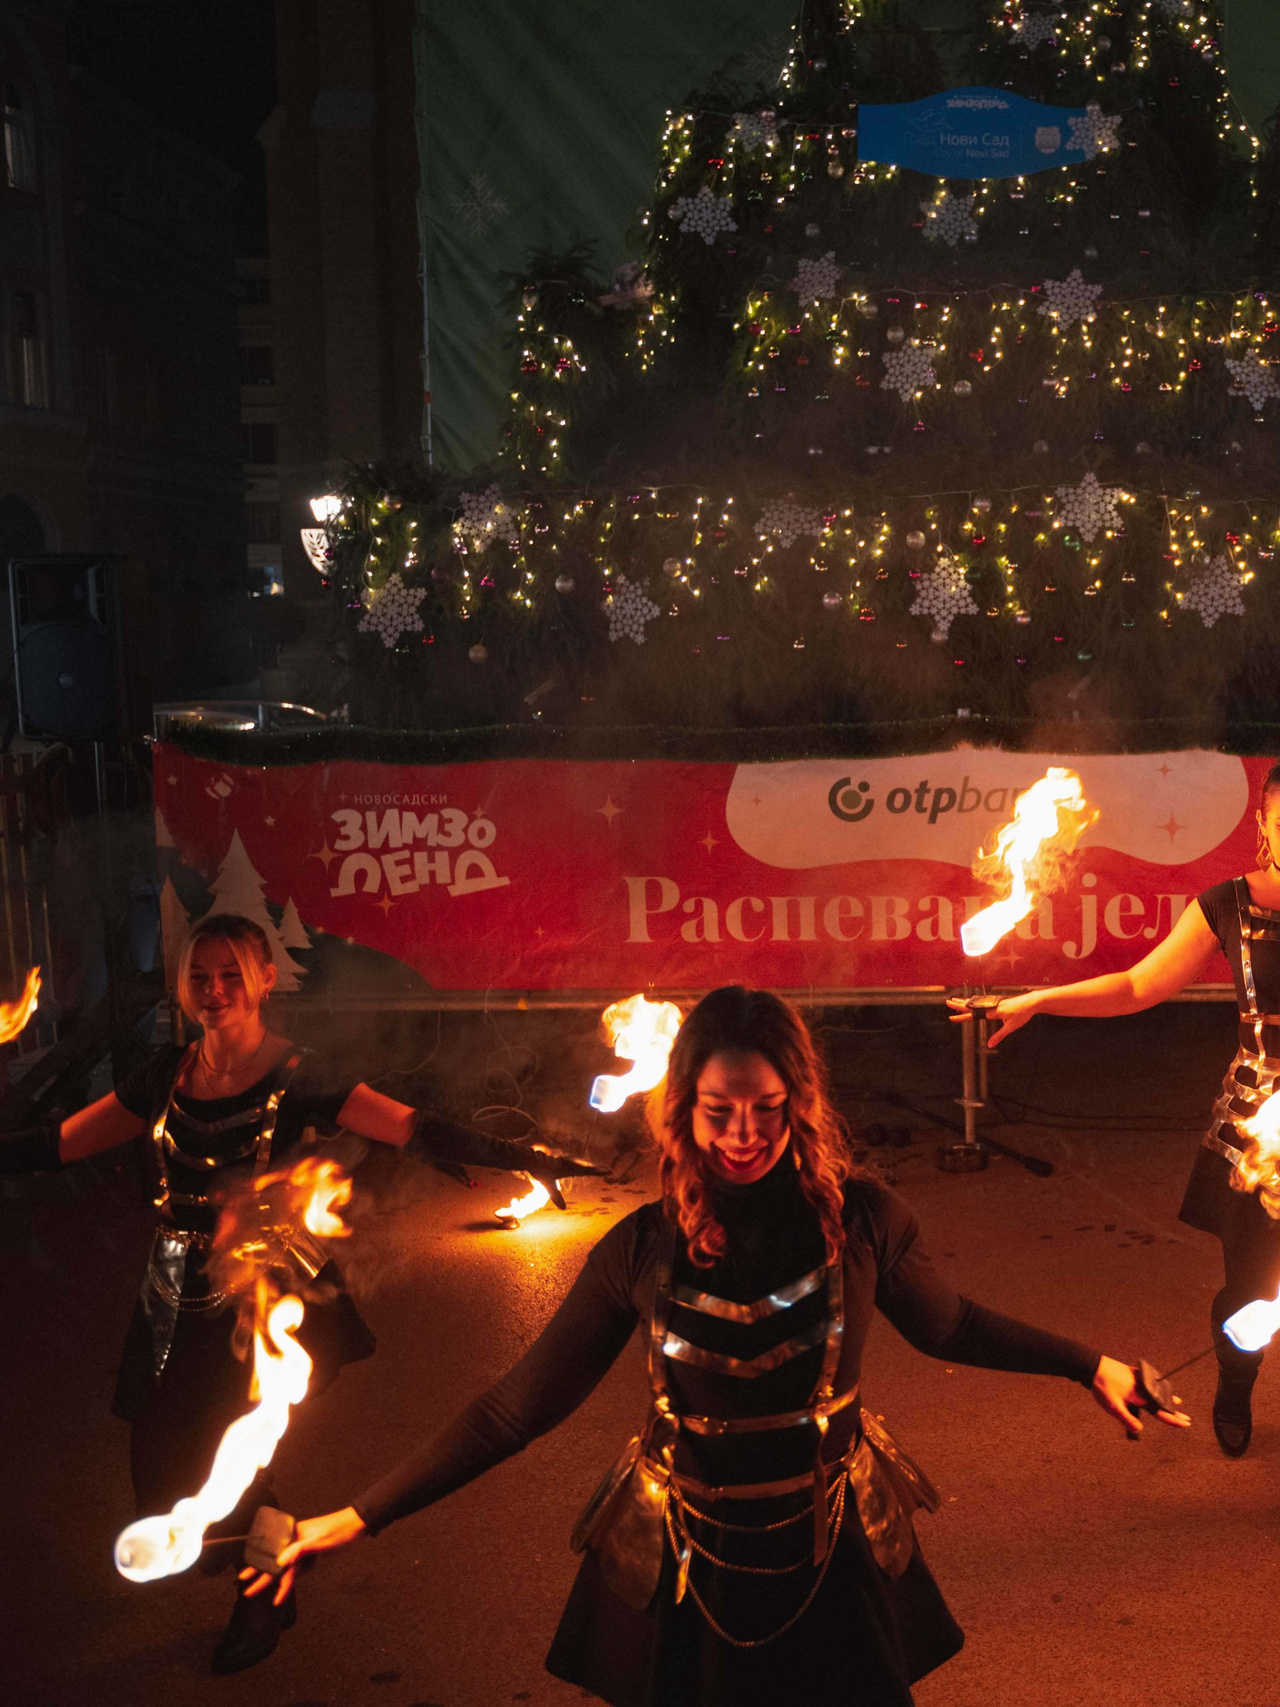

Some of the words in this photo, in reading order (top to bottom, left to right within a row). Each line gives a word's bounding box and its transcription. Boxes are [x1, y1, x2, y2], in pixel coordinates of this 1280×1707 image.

[940, 133, 978, 146] Нови
[982, 132, 1010, 147] Сад
[966, 149, 989, 158] Novi
[991, 149, 1010, 158] Sad
[354, 794, 448, 806] НОВОСАДСКИ
[886, 776, 1023, 824] otpba
[330, 850, 511, 897] ЛЕНД
